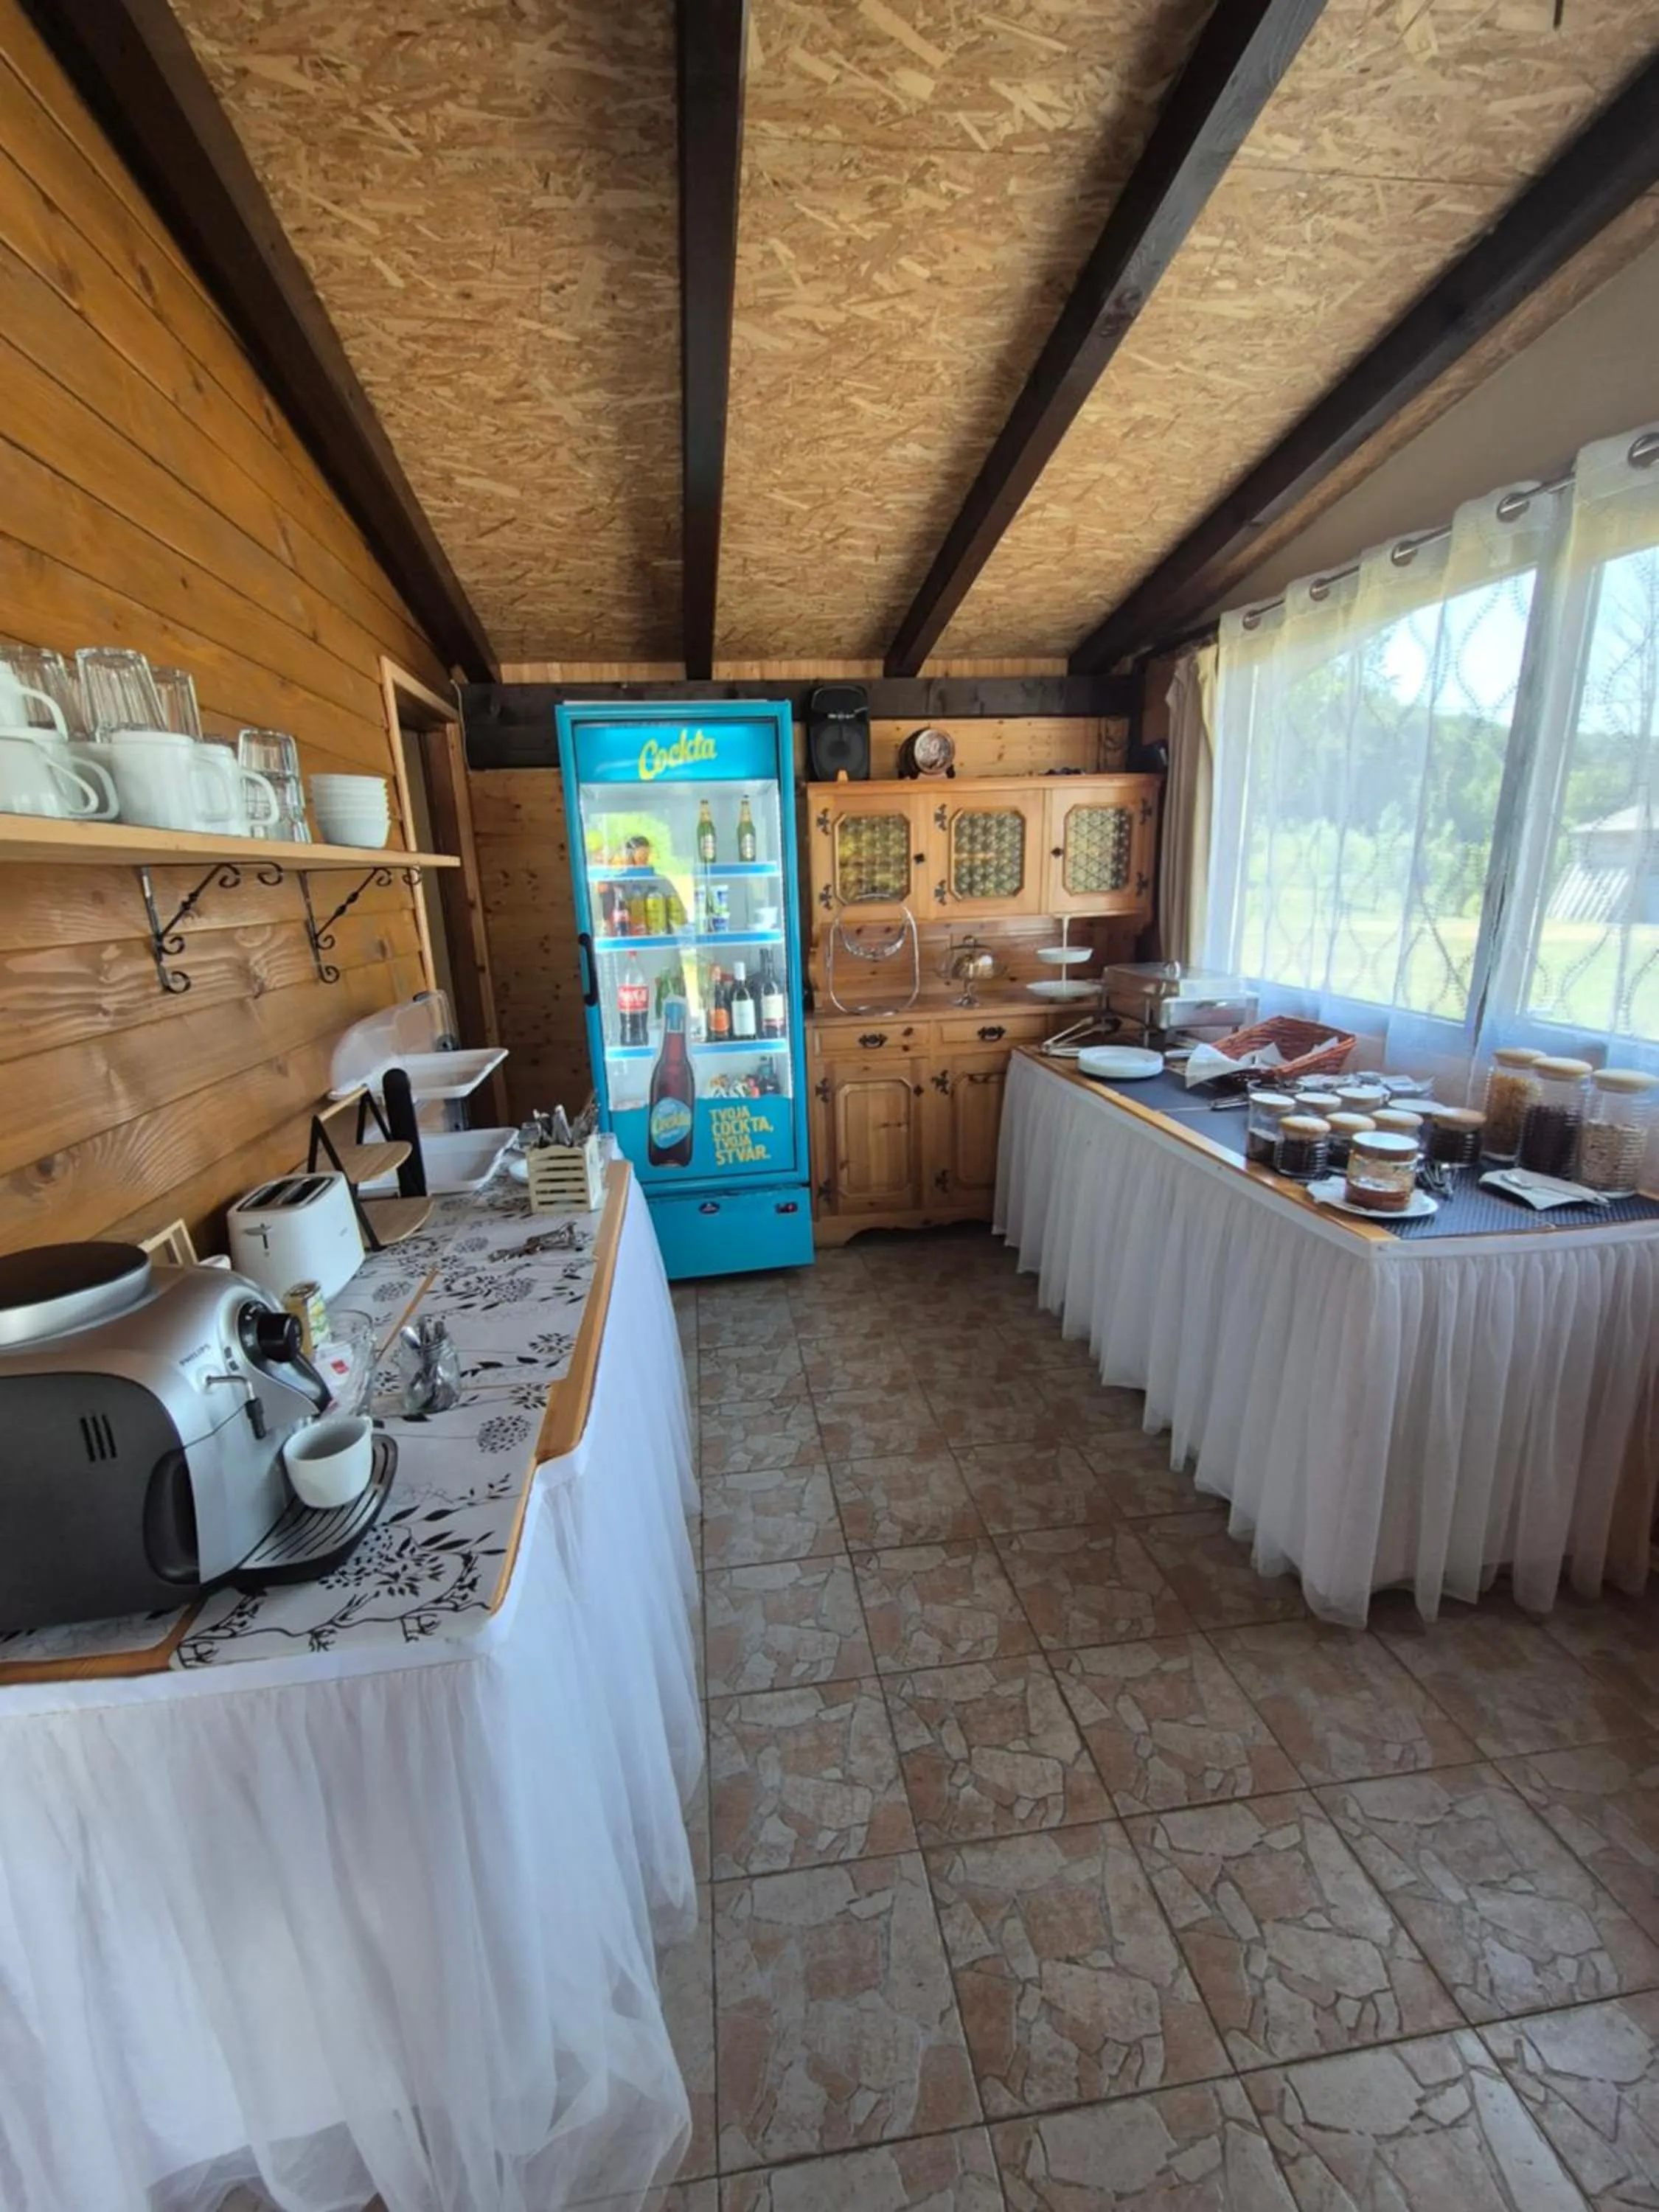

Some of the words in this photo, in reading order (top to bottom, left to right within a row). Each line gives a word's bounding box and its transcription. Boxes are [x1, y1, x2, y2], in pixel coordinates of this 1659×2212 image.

[639, 728, 717, 780] Cockta
[709, 1105, 751, 1121] TVOJA
[712, 1116, 773, 1135] COCKTA,
[714, 1134, 752, 1150] TVOJA
[716, 1144, 771, 1166] STVAR.
